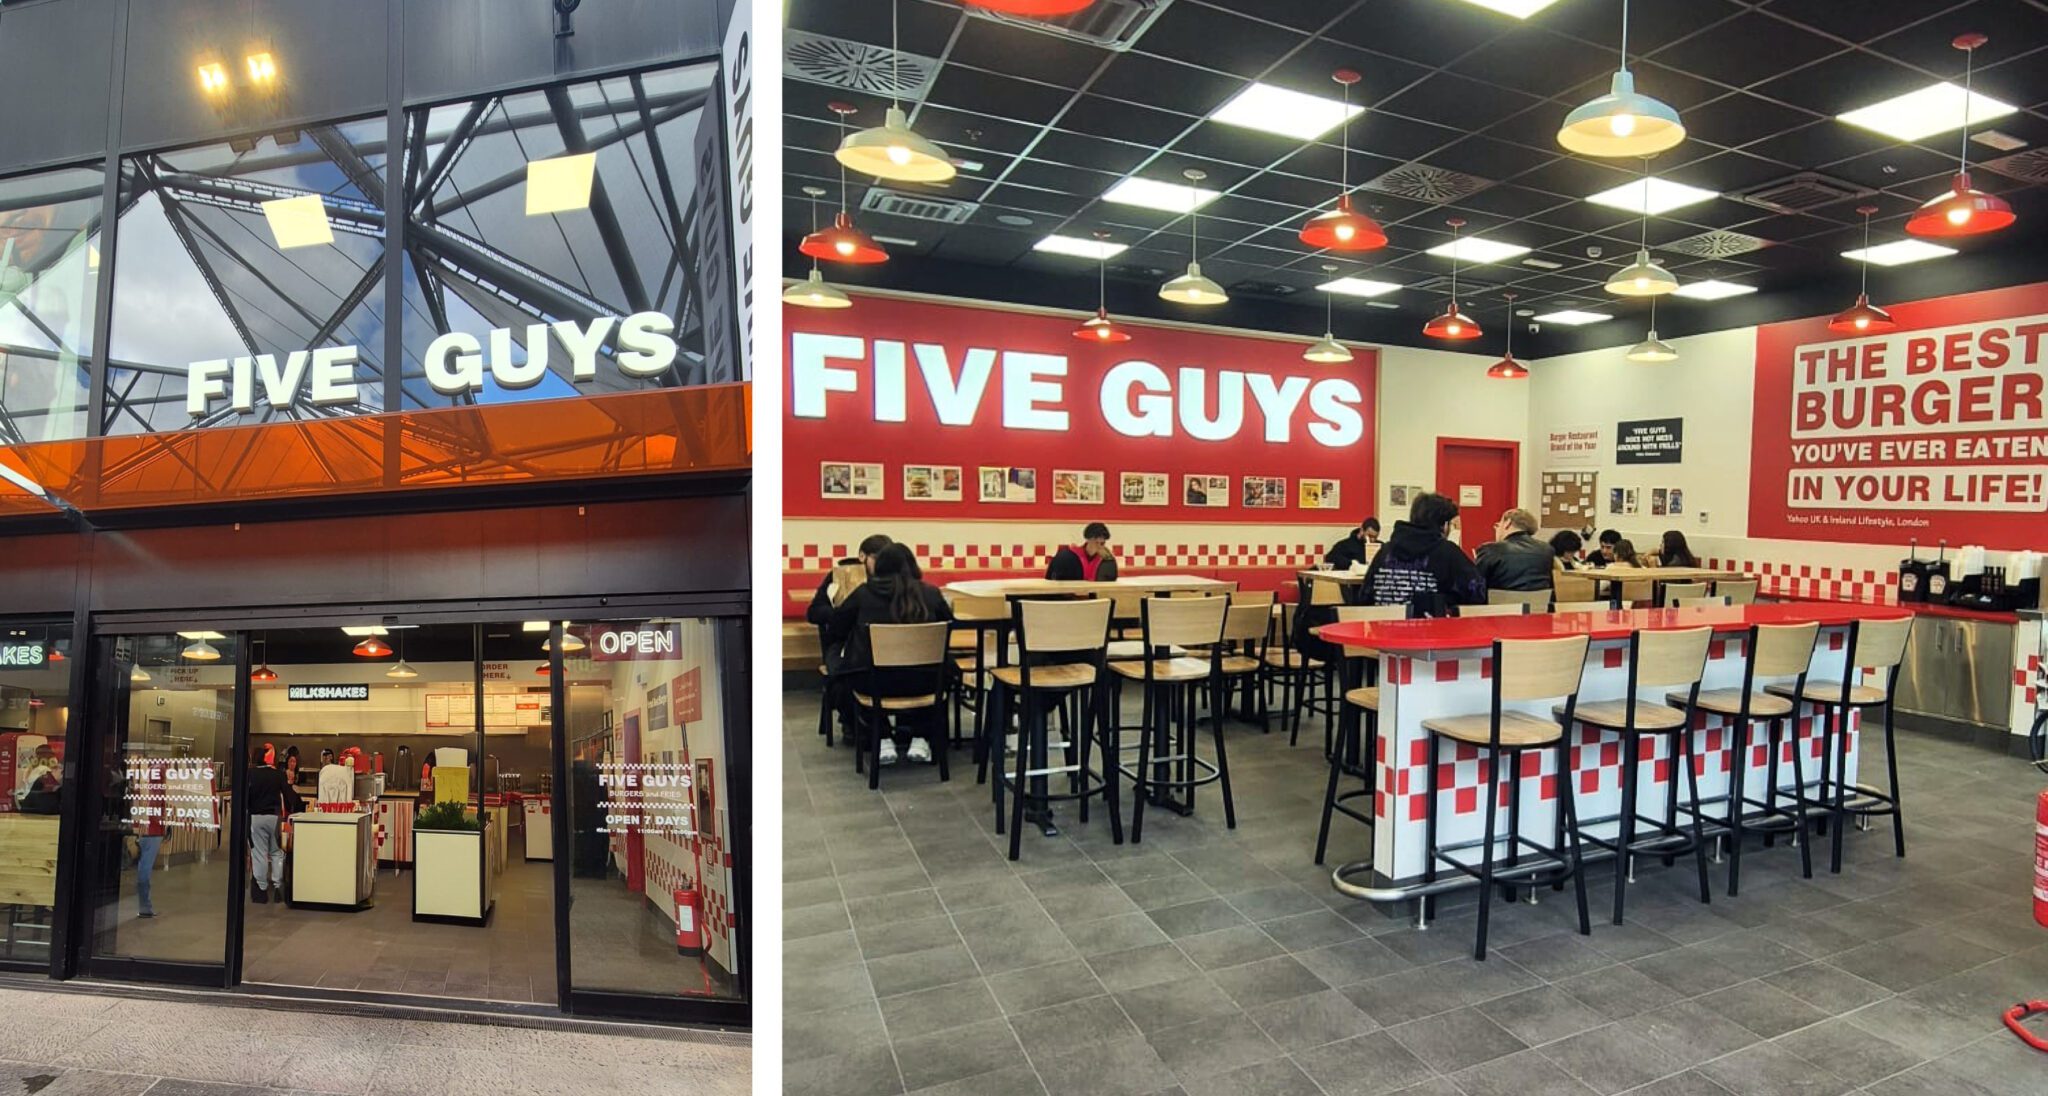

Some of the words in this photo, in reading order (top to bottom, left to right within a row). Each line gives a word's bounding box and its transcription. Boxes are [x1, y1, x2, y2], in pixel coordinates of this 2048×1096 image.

[187, 345, 360, 417] FIVE
[424, 311, 677, 395] GUYS
[1799, 342, 1888, 385] THE
[1906, 323, 2048, 375] BEST
[791, 331, 1070, 431] FIVE
[1100, 360, 1364, 448] GUYS
[1796, 373, 2044, 431] BURGER
[1791, 441, 1872, 463] YOU'VE
[1880, 440, 1946, 461] EVER
[1955, 436, 2048, 459] EATEN
[1792, 475, 1823, 501] IN
[1834, 475, 1930, 502] YOUR
[1944, 474, 2042, 503] LIFE!
[1787, 515, 1809, 523] Yahoo
[1811, 516, 1821, 524] UK
[1830, 516, 1856, 525] Ireland
[1897, 517, 1930, 527] London
[600, 630, 673, 654] OPEN
[0, 645, 43, 665] KES
[289, 687, 367, 699] MILKSHAKES
[126, 769, 161, 780] FIVE
[165, 767, 214, 780] GUYS
[598, 774, 638, 787] FIVE
[642, 774, 691, 788] GUYS
[130, 806, 162, 816] OPEN
[166, 808, 173, 816] 7
[177, 808, 211, 818] DAYS
[605, 814, 639, 825] OPEN
[644, 816, 651, 825] 7
[655, 816, 689, 826] DAYS
